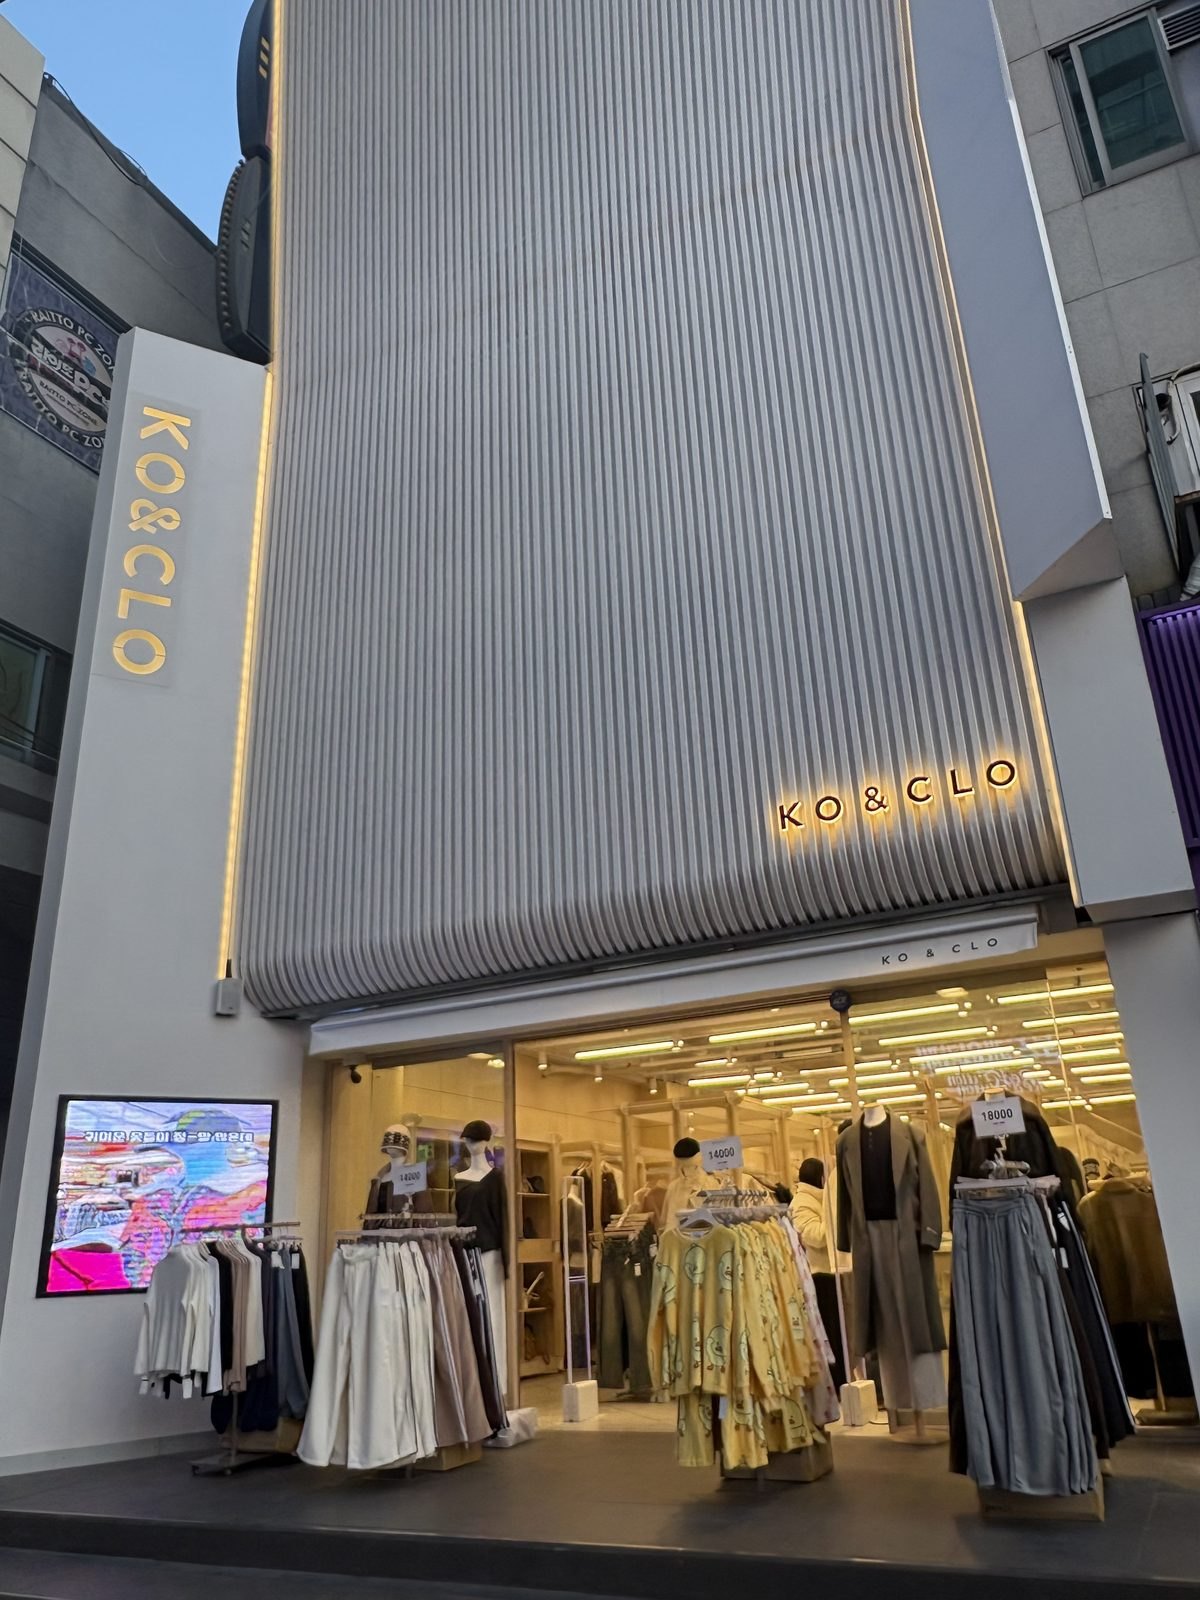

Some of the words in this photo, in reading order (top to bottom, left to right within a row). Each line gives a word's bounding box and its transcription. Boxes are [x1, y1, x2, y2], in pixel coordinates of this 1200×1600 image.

[77, 327, 95, 345] PC
[62, 424, 80, 442] PC
[112, 406, 193, 676] KO&CLO
[981, 1108, 1013, 1121] 18000
[708, 1147, 735, 1160] 14000
